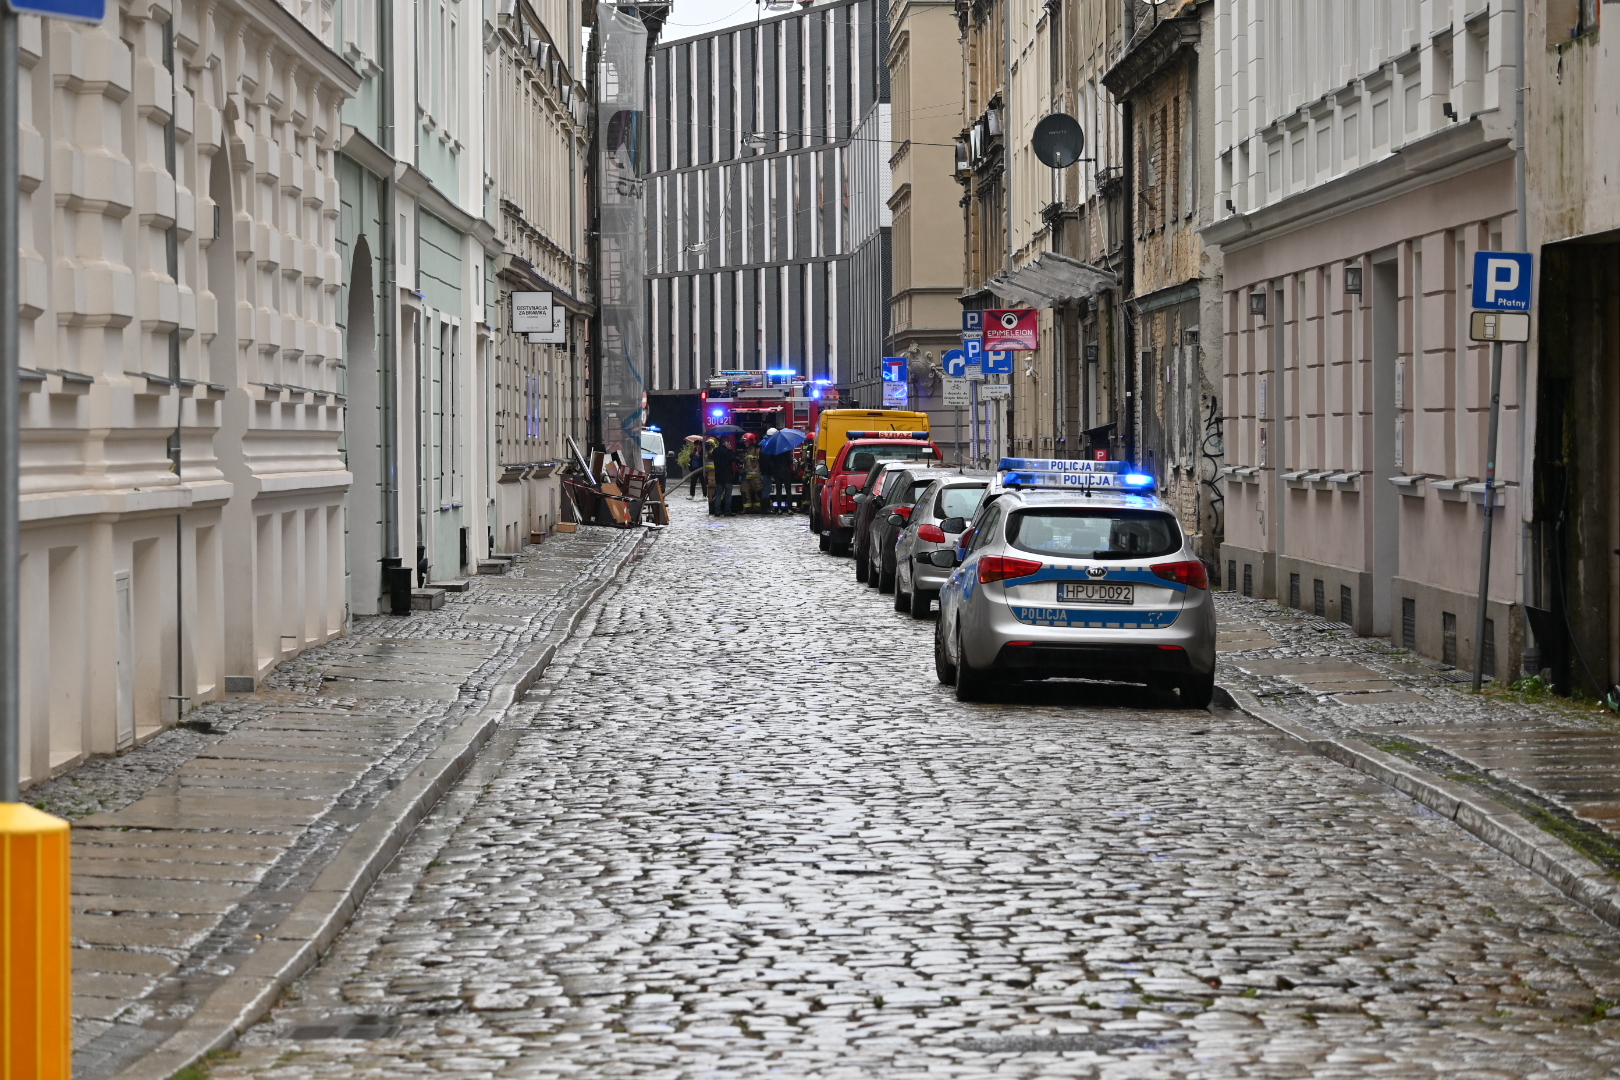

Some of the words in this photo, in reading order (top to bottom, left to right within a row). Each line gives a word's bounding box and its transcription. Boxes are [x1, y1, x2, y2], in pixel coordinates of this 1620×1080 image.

[1485, 258, 1520, 303] P
[1497, 298, 1526, 309] Płatny
[967, 312, 979, 329] P
[967, 341, 979, 358] P
[1097, 451, 1105, 460] P
[1050, 461, 1092, 472] POLICJA
[1063, 474, 1110, 486] POLICJA
[1065, 585, 1095, 599] HPU
[1099, 586, 1131, 600] D092
[1021, 608, 1068, 621] POLICJA
